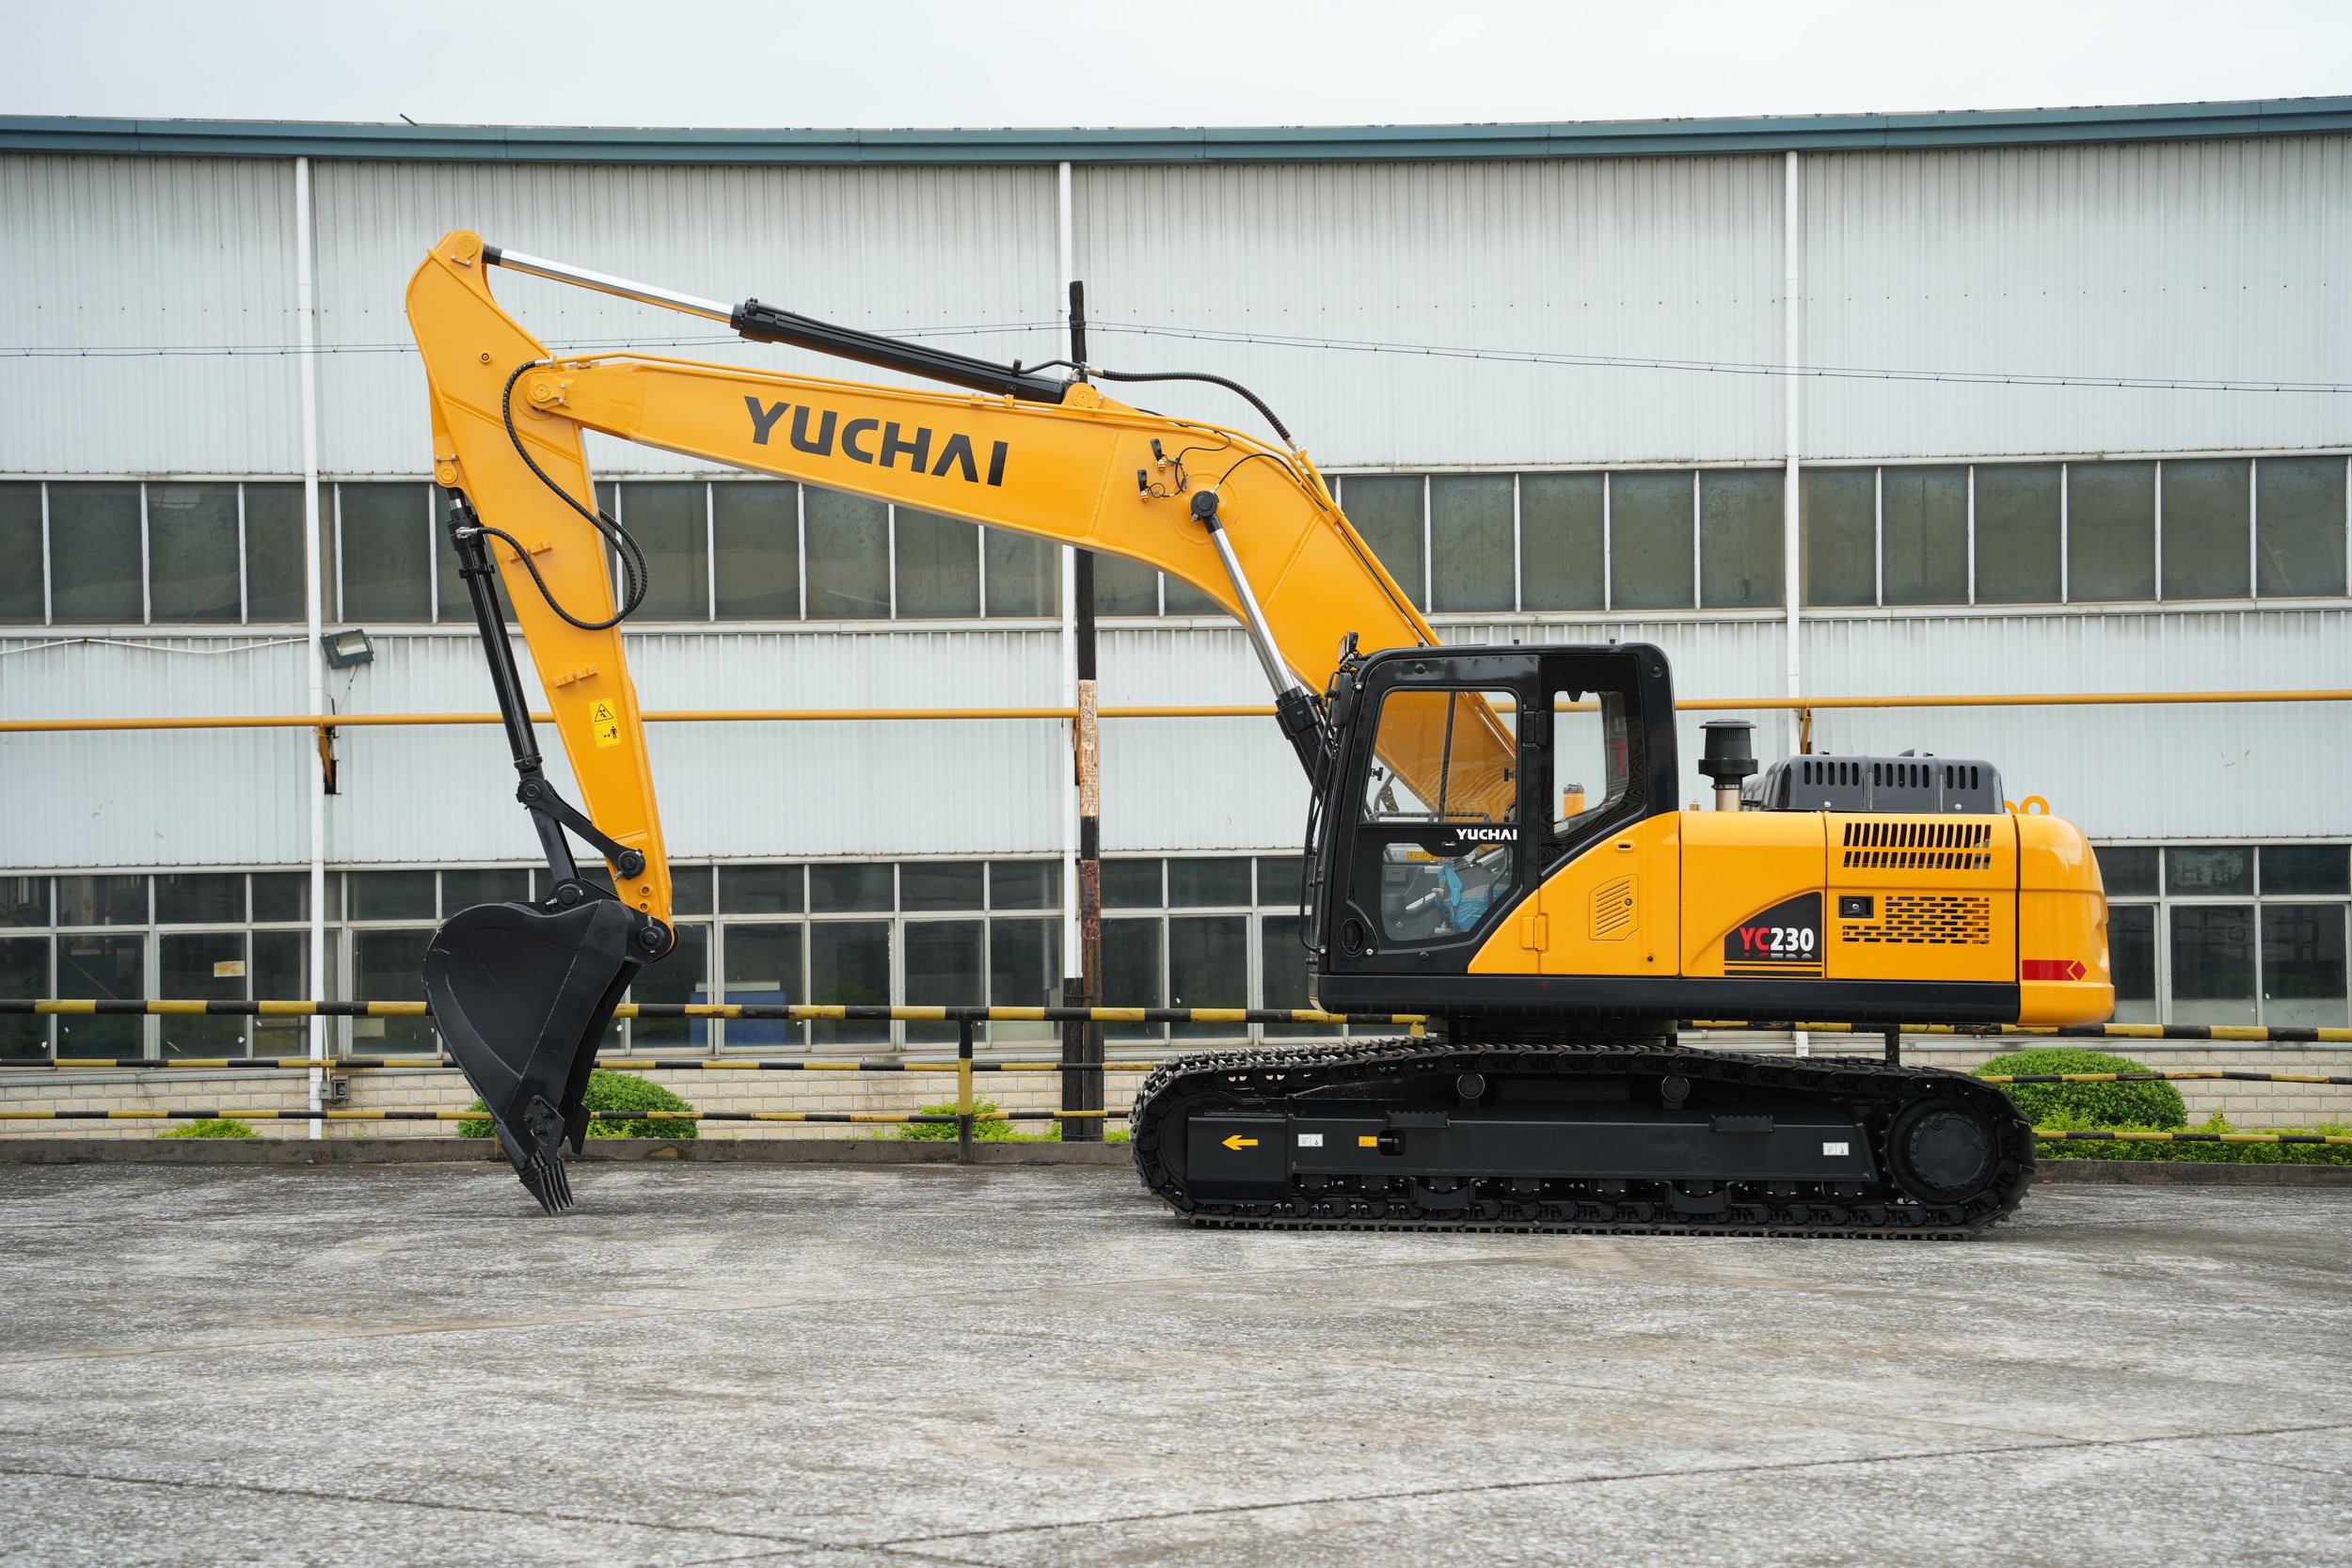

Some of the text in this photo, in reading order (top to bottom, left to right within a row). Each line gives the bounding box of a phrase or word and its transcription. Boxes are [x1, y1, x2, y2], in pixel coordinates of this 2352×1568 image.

[743, 395, 1009, 486] YUCHAI
[1455, 829, 1518, 840] YUCHAI
[1739, 927, 1815, 952] YC230
